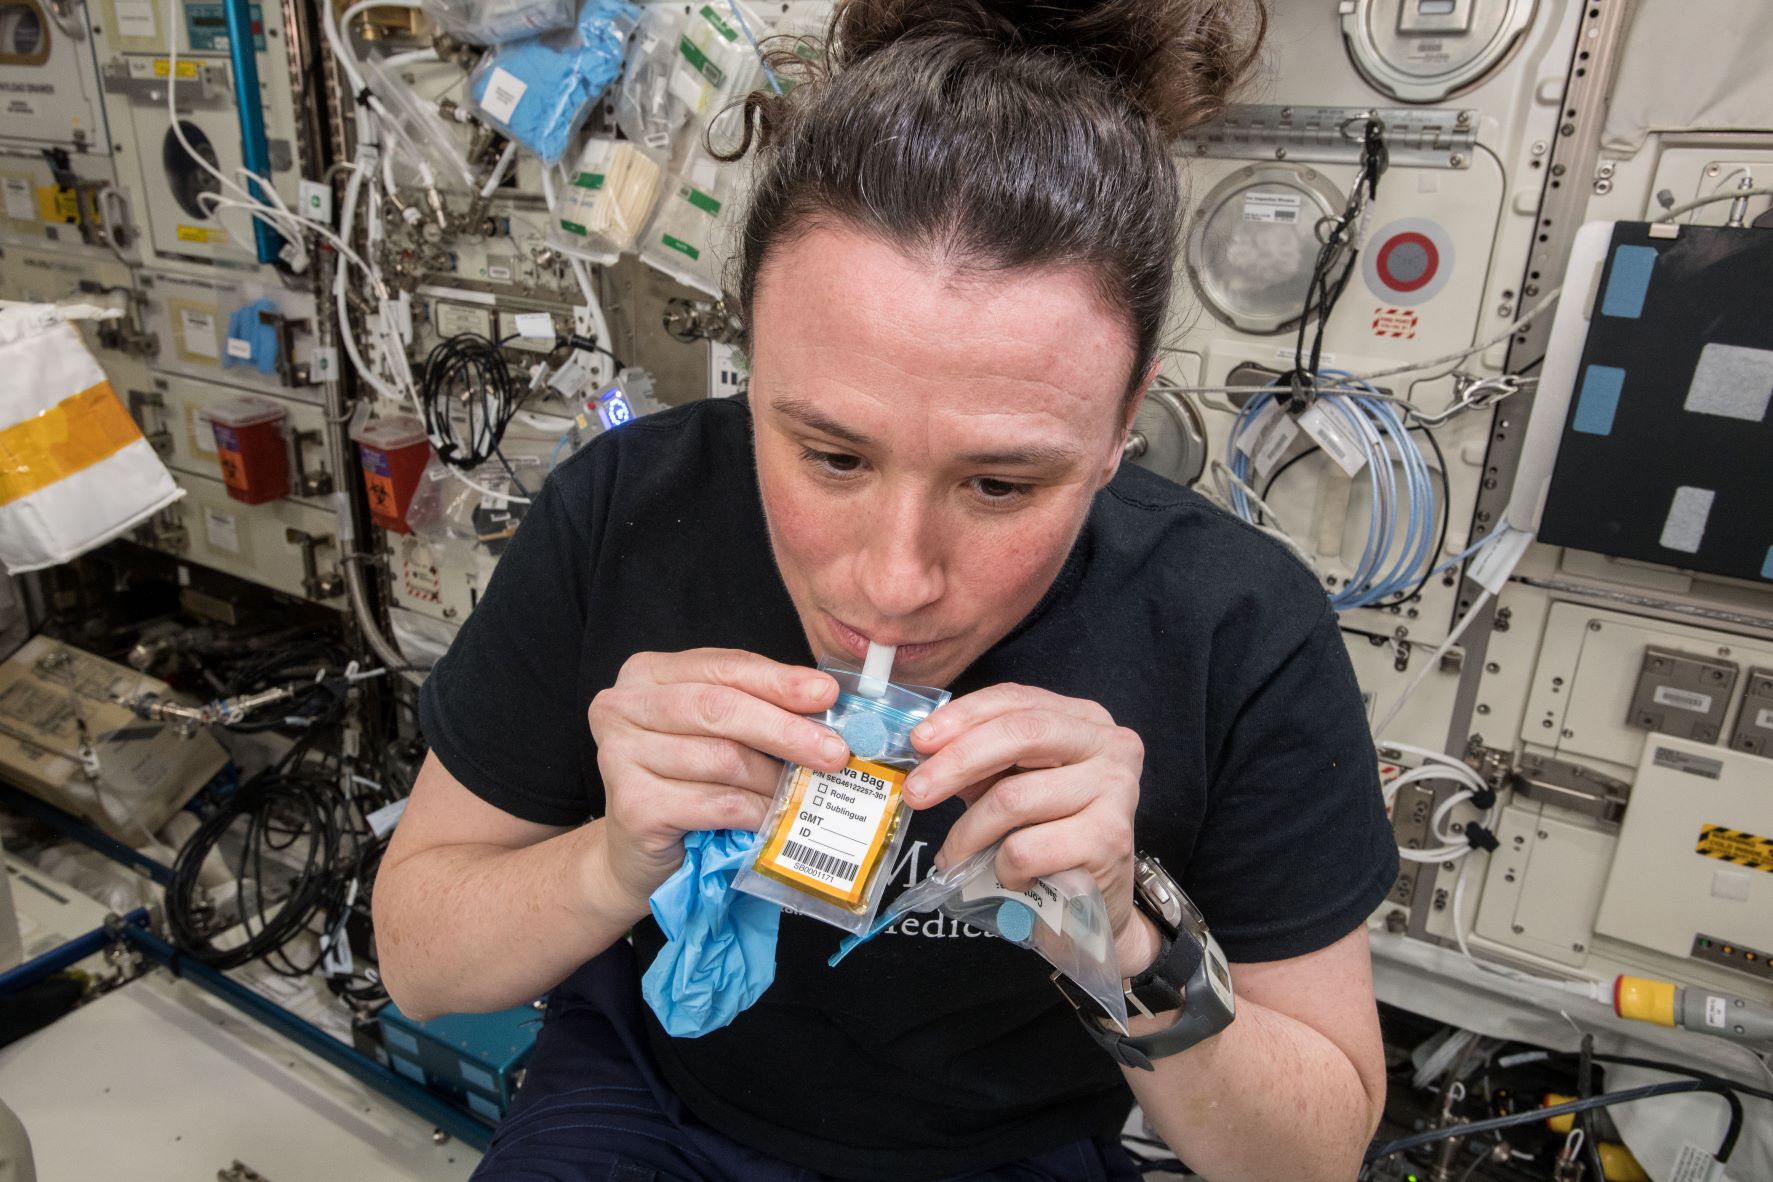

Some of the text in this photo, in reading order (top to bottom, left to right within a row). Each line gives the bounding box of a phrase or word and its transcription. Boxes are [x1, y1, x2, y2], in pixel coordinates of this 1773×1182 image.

[826, 773, 887, 801] SEG46122257-301
[861, 772, 885, 790] Bag
[830, 789, 856, 804] Rolled
[799, 811, 824, 826] GMT
[825, 802, 867, 822] Sublingual
[799, 827, 811, 838] ID
[793, 862, 835, 883] SB0001171
[884, 907, 1000, 938] edic
